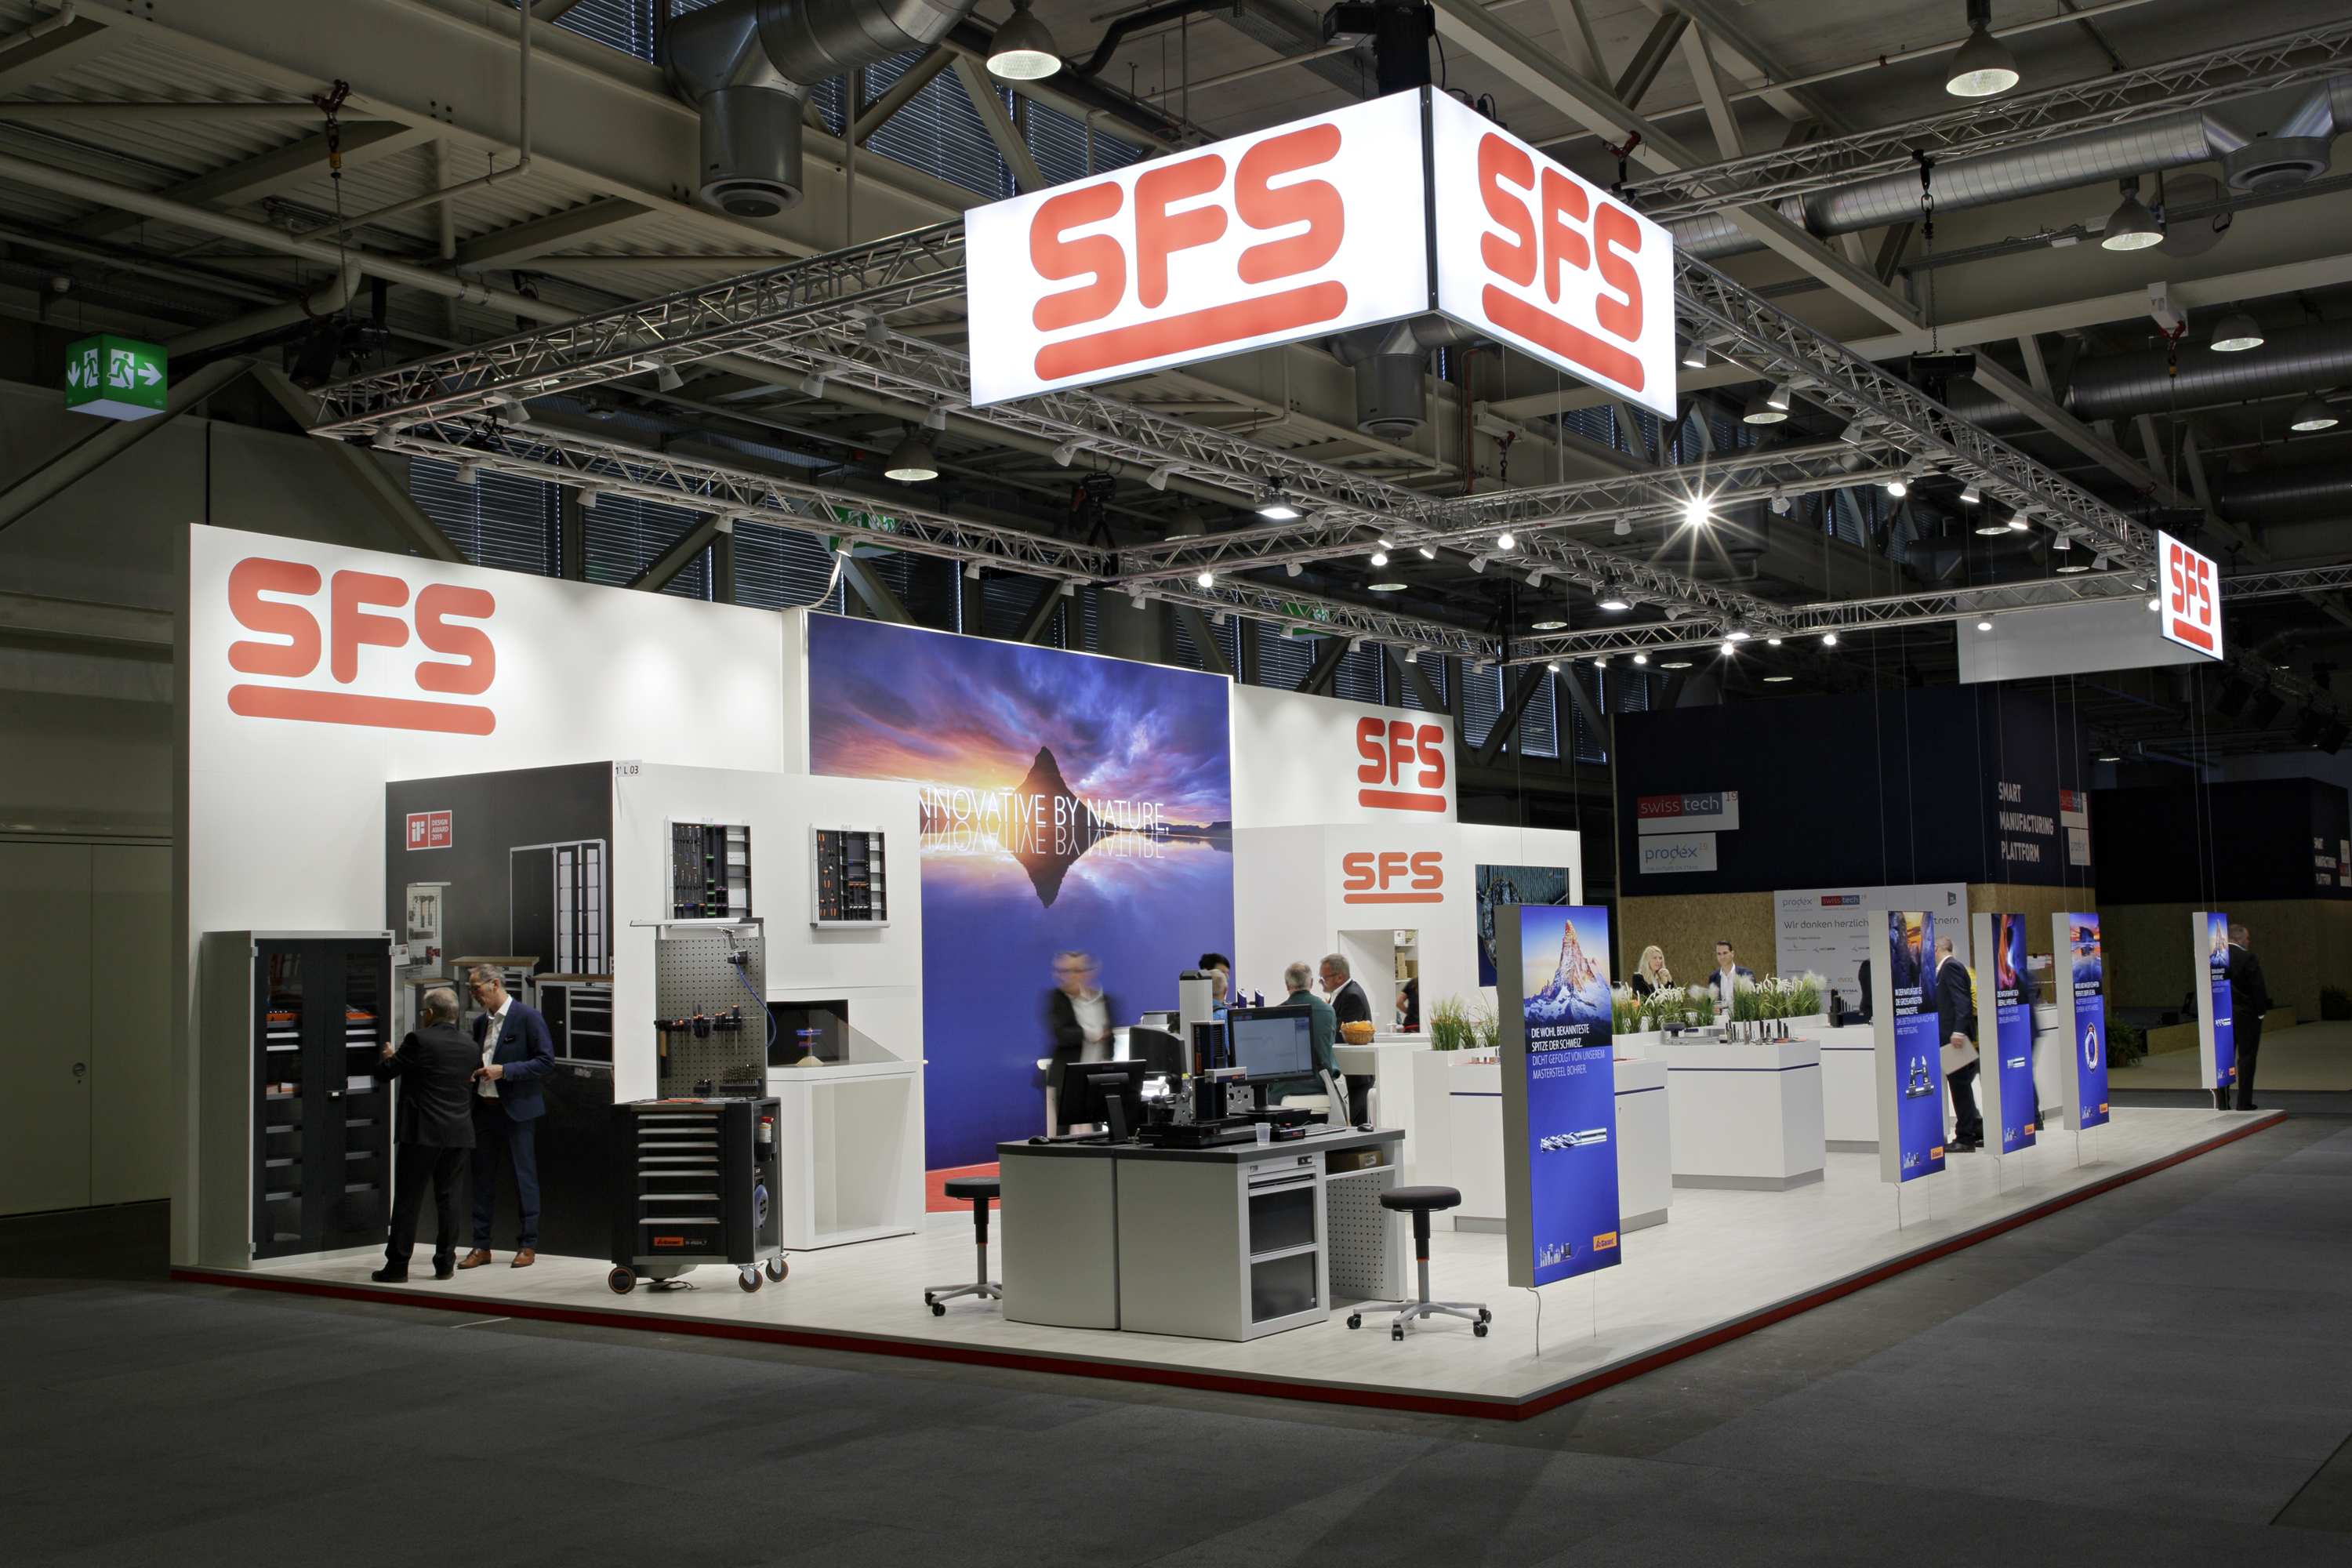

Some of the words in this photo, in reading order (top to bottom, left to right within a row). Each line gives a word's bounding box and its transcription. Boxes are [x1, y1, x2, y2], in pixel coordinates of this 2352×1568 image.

[1029, 123, 1345, 332] SFS
[1478, 132, 1643, 343] SFS
[2170, 543, 2211, 626] SFS
[228, 557, 495, 695] SFS
[1356, 717, 1445, 789] SFS
[630, 765, 638, 774] 03
[1726, 792, 1738, 801] 19
[1998, 782, 2021, 802] SMART
[1054, 795, 1080, 826] BY
[1087, 798, 1169, 831] NATURE.
[1999, 811, 2053, 835] MANUFACTURING
[1646, 845, 1697, 863] prodex
[2001, 840, 2039, 862] PLATTFORM
[1343, 851, 1443, 890] SFS
[1801, 920, 1832, 929] danken
[1835, 919, 1869, 927] herzlich
[1541, 1027, 1556, 1037] WOHL
[1557, 1024, 1589, 1036] BEKANNTESTE
[1532, 1041, 1548, 1052] SPITZE
[1549, 1040, 1559, 1051] DER
[1560, 1038, 1582, 1049] SCHWEIZ.
[1533, 1054, 1548, 1065] DICHT
[1548, 1052, 1570, 1064] GEFOLGT
[1571, 1051, 1582, 1062] VON
[1583, 1049, 1605, 1060] UNSEREM
[1533, 1067, 1566, 1080] MASTERSTEEL
[1567, 1065, 1587, 1076] BOHRER.
